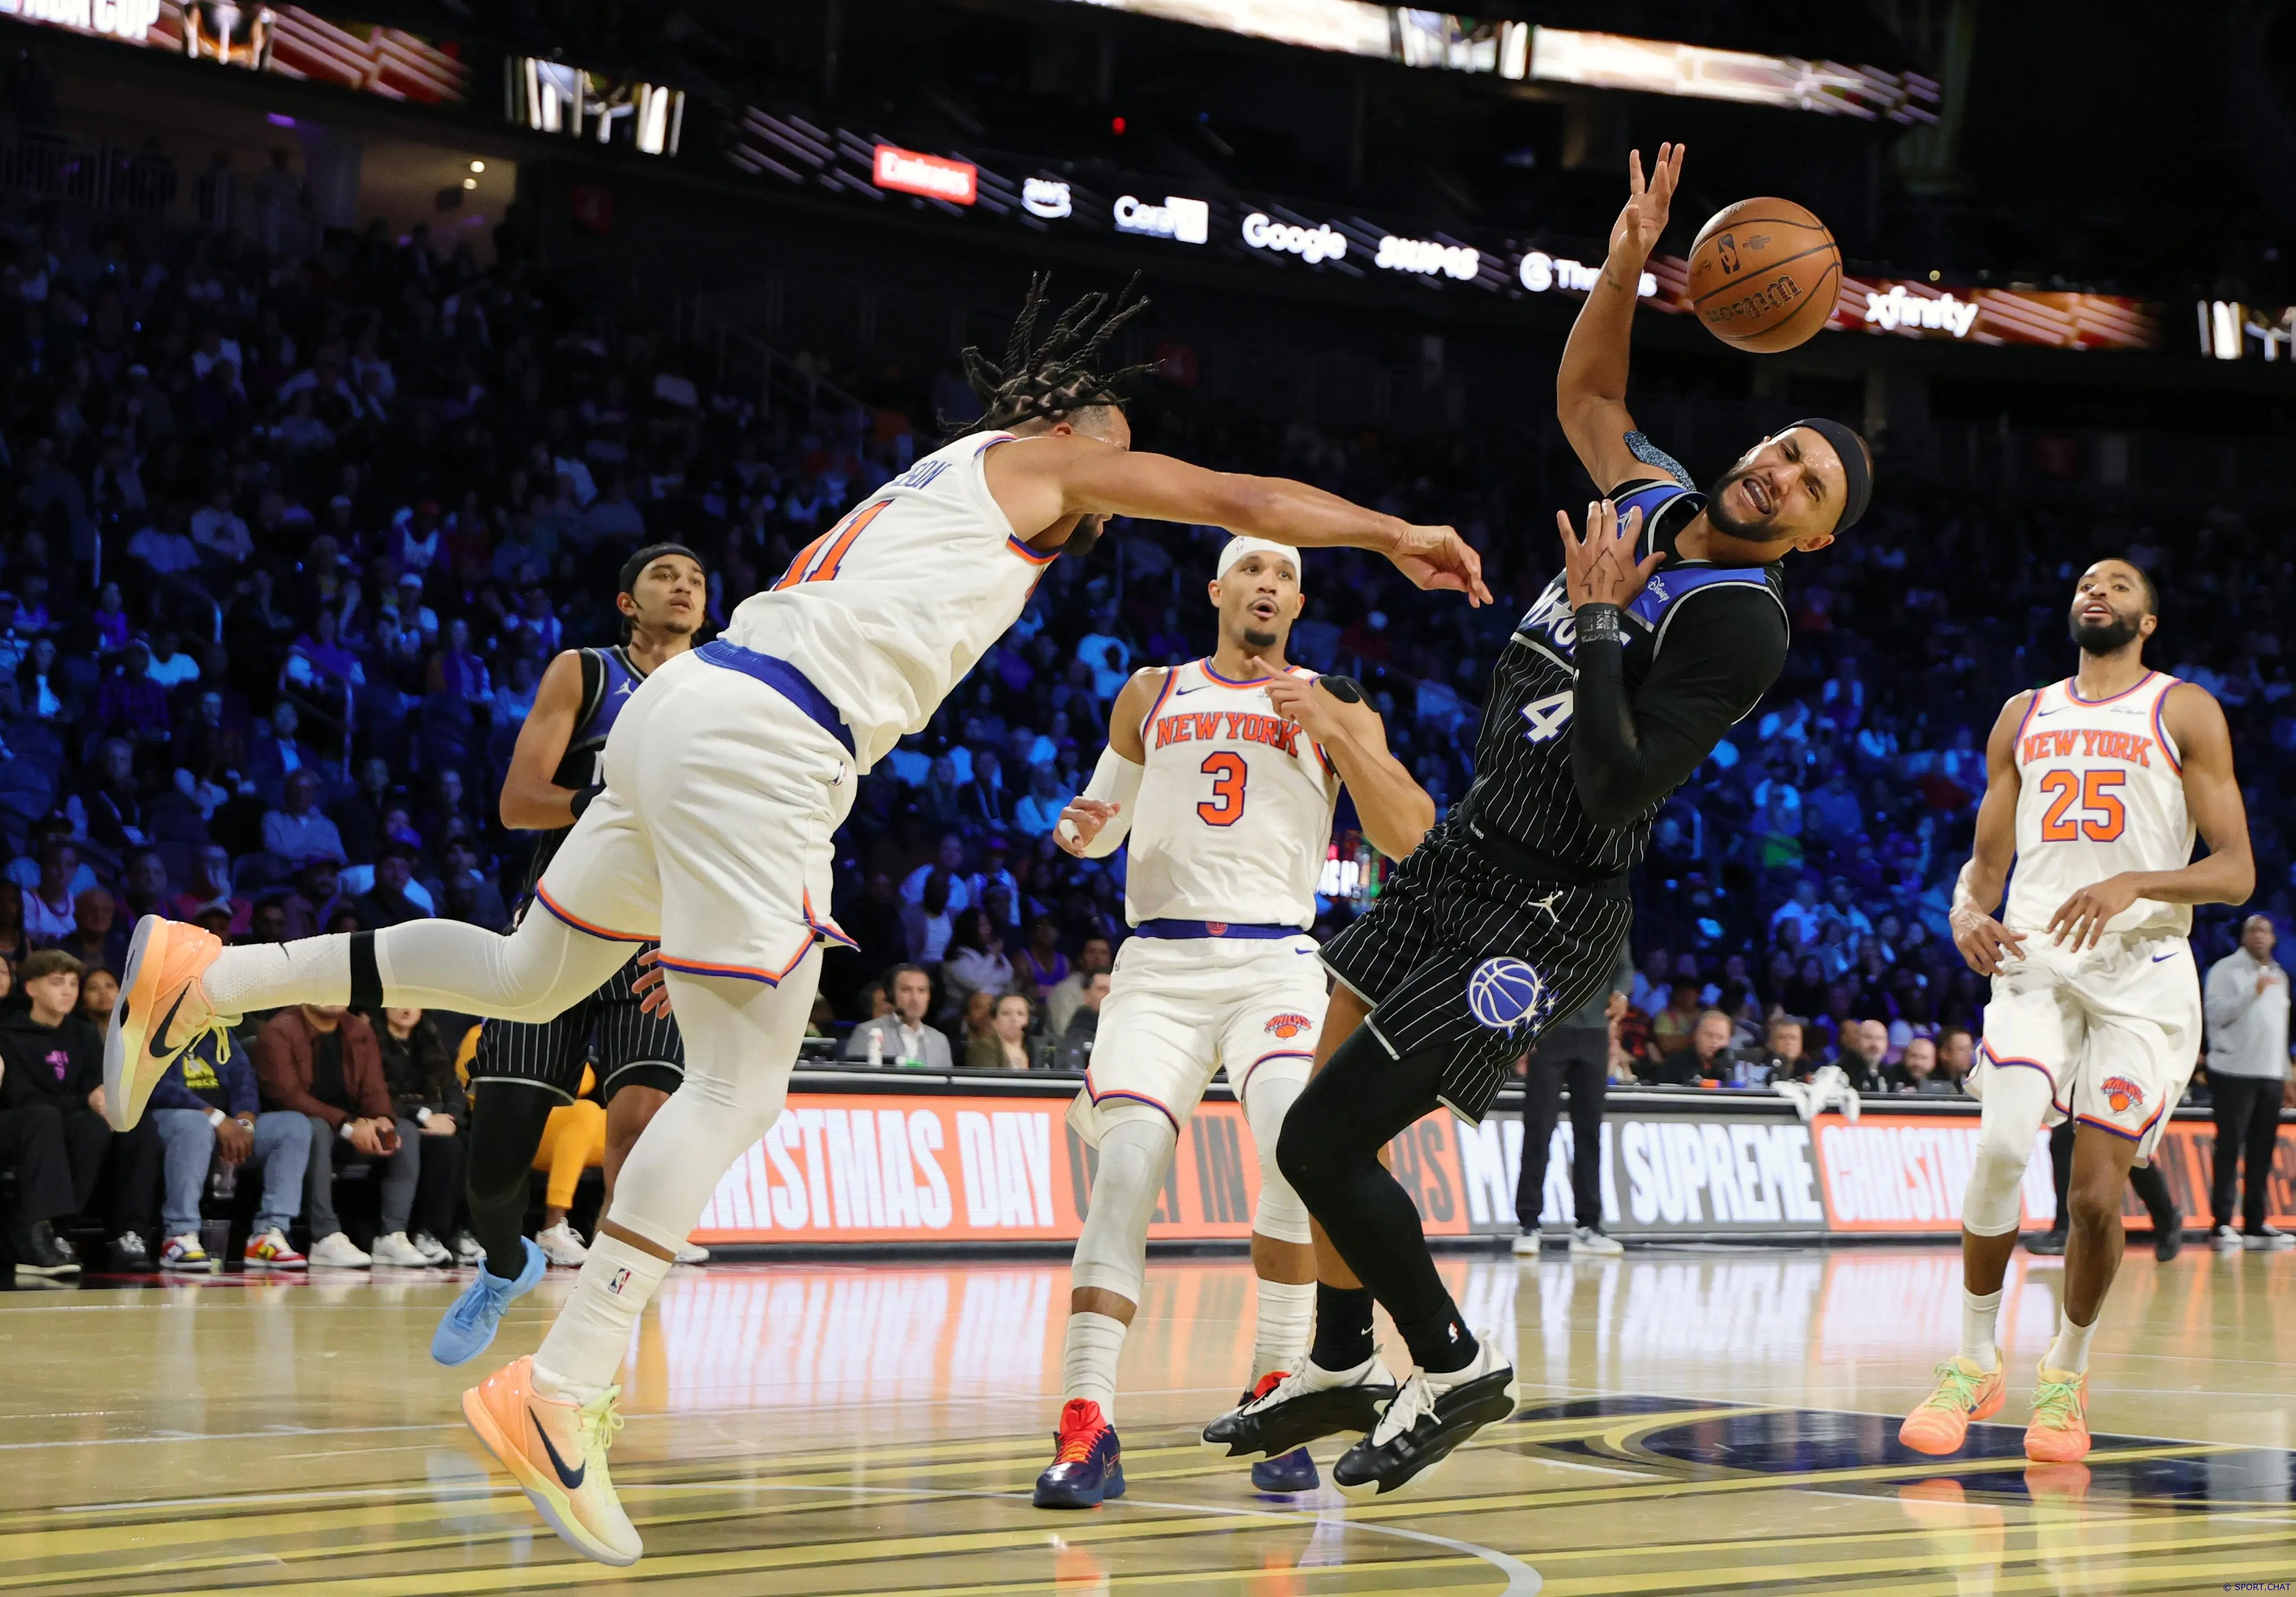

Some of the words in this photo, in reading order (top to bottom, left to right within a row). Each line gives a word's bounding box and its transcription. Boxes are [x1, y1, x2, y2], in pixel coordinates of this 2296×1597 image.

[93, 0, 160, 41] CUP
[1242, 213, 1347, 264] Google
[1705, 275, 1803, 323] Wilson
[1865, 285, 1979, 338] xfinity
[771, 498, 896, 593] 11
[1155, 712, 1223, 751] NEW
[1225, 712, 1302, 759] YORK
[1519, 690, 1574, 745] 4
[2023, 730, 2080, 767] NEW
[2082, 729, 2154, 768] YORK
[1197, 751, 1248, 827] 3
[2040, 769, 2126, 842] 25
[955, 1111, 1054, 1228] DAY
[1192, 1116, 1250, 1223] IN
[1621, 1120, 1824, 1224] SUPREME
